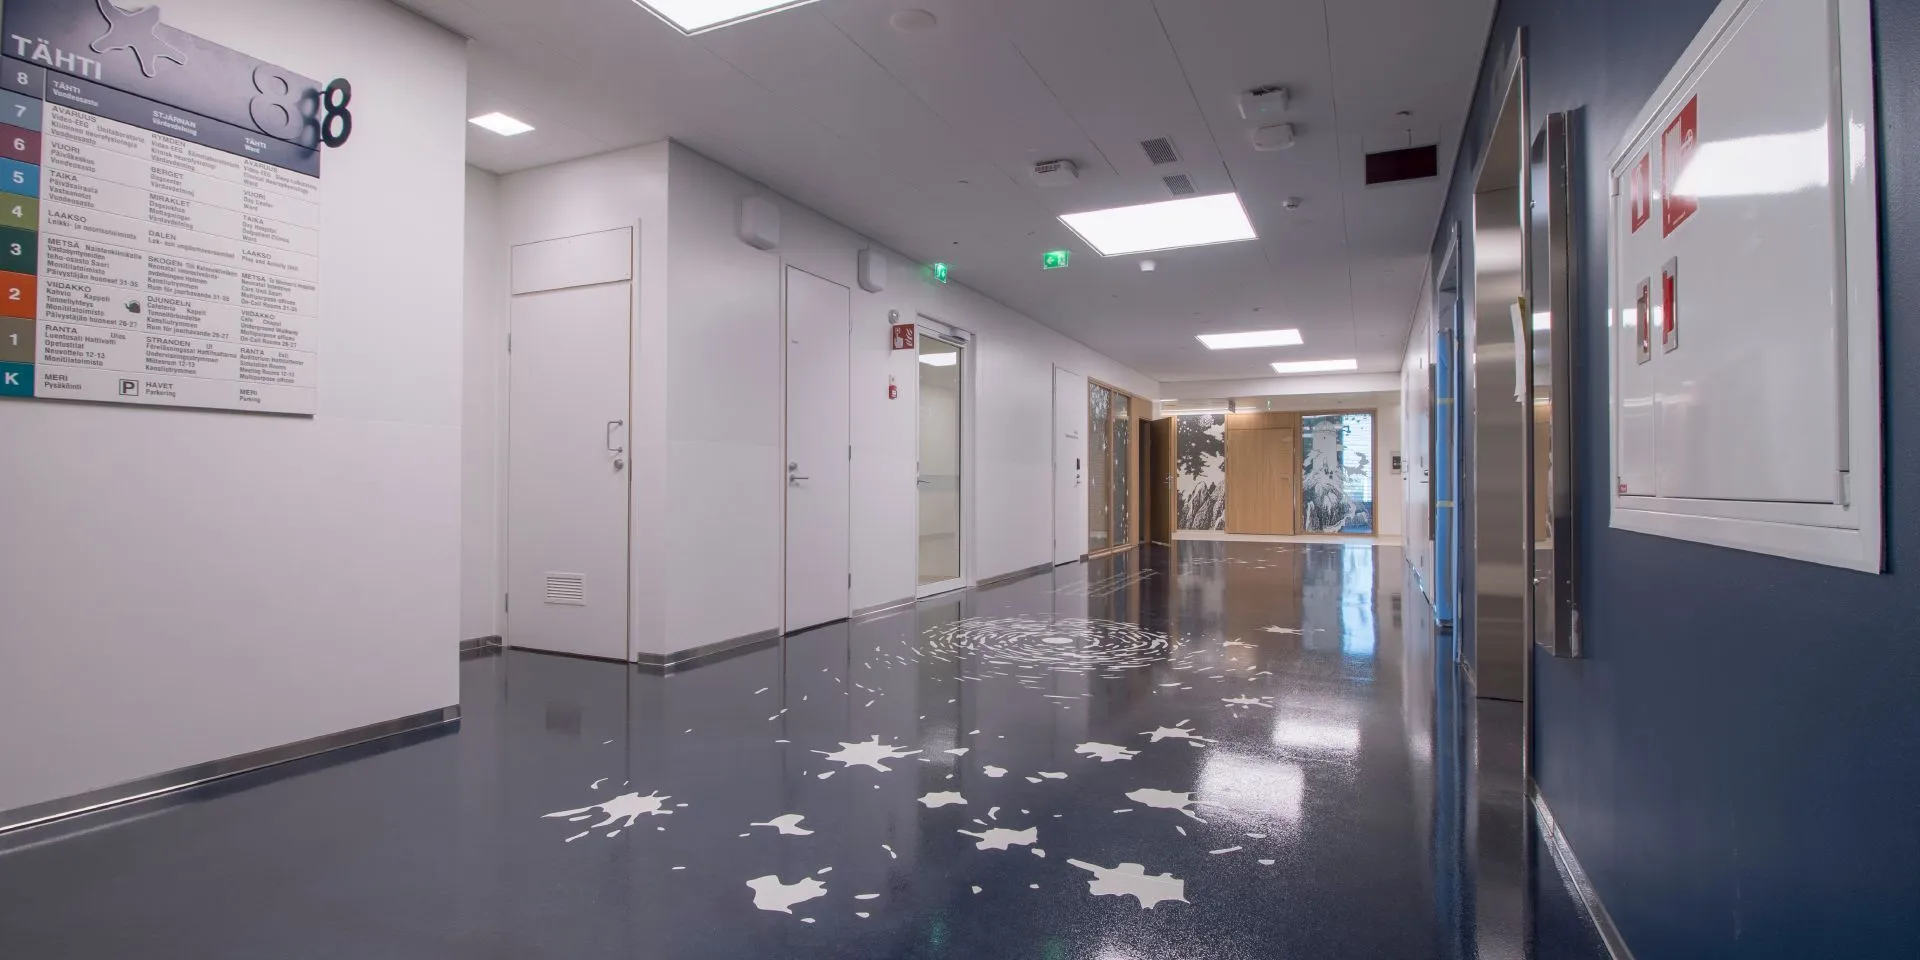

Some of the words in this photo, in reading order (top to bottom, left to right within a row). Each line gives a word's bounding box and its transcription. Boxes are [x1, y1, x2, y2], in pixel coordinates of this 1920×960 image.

[11, 33, 102, 80] TÄHTI
[17, 72, 28, 86] 8
[52, 79, 80, 94] TÄHTI
[52, 88, 98, 107] Vuodeosasto
[14, 104, 26, 118] 7
[52, 104, 96, 122] AVARUUS
[321, 78, 352, 148] 8
[51, 112, 88, 128] Video-EEG
[152, 109, 195, 128] STJÄRNAN
[51, 128, 96, 145] Vuodeosasto
[151, 132, 185, 147] RYMDEN
[245, 136, 266, 149] TÄHTI
[14, 138, 26, 151] 6
[51, 141, 79, 154] VUORI
[151, 139, 182, 153] Video-EEG
[50, 156, 95, 172] Vuodeosasto
[244, 158, 277, 173] AVARUUS
[13, 171, 24, 184] 5
[49, 169, 77, 181] TAIKA
[151, 166, 183, 179] BERGET
[48, 193, 93, 208] Vuodeosasto
[149, 192, 190, 207] MIRAKLET
[243, 189, 265, 200] VUORI
[12, 206, 23, 218] 4
[48, 209, 86, 223] LAAKSO
[243, 214, 263, 224] TAIKA
[47, 235, 79, 248] METSÄ
[148, 230, 175, 240] DALEN
[10, 243, 22, 256] 3
[242, 248, 271, 259] LAAKSO
[47, 252, 88, 264] teho-osasto
[148, 255, 182, 267] SKOGEN
[47, 259, 104, 274] Monitilatoimisto
[46, 267, 88, 280] Päivystäjän
[241, 271, 265, 281] METSÄ
[46, 280, 91, 292] VIIDAKKO
[8, 288, 20, 300] 2
[46, 288, 71, 296] Kahvio
[83, 293, 110, 303] Kappeli
[46, 295, 93, 307] Tunneliyhteys
[147, 295, 190, 307] DJUNGELN
[45, 310, 87, 322] Päivystäjän
[46, 303, 104, 316] Monitilatoimisto
[241, 309, 274, 319] VIIDAKKO
[45, 324, 77, 334] RANTA
[9, 333, 18, 346] 1
[45, 331, 83, 341] Luentosali
[146, 336, 190, 346] STRANDEN
[45, 339, 84, 349] Opetustilat
[44, 354, 103, 366] Monitilatoimisto
[4, 372, 19, 386] K
[44, 381, 81, 390] Pysäköinti
[122, 382, 134, 394] P
[145, 388, 176, 397] Parkering
